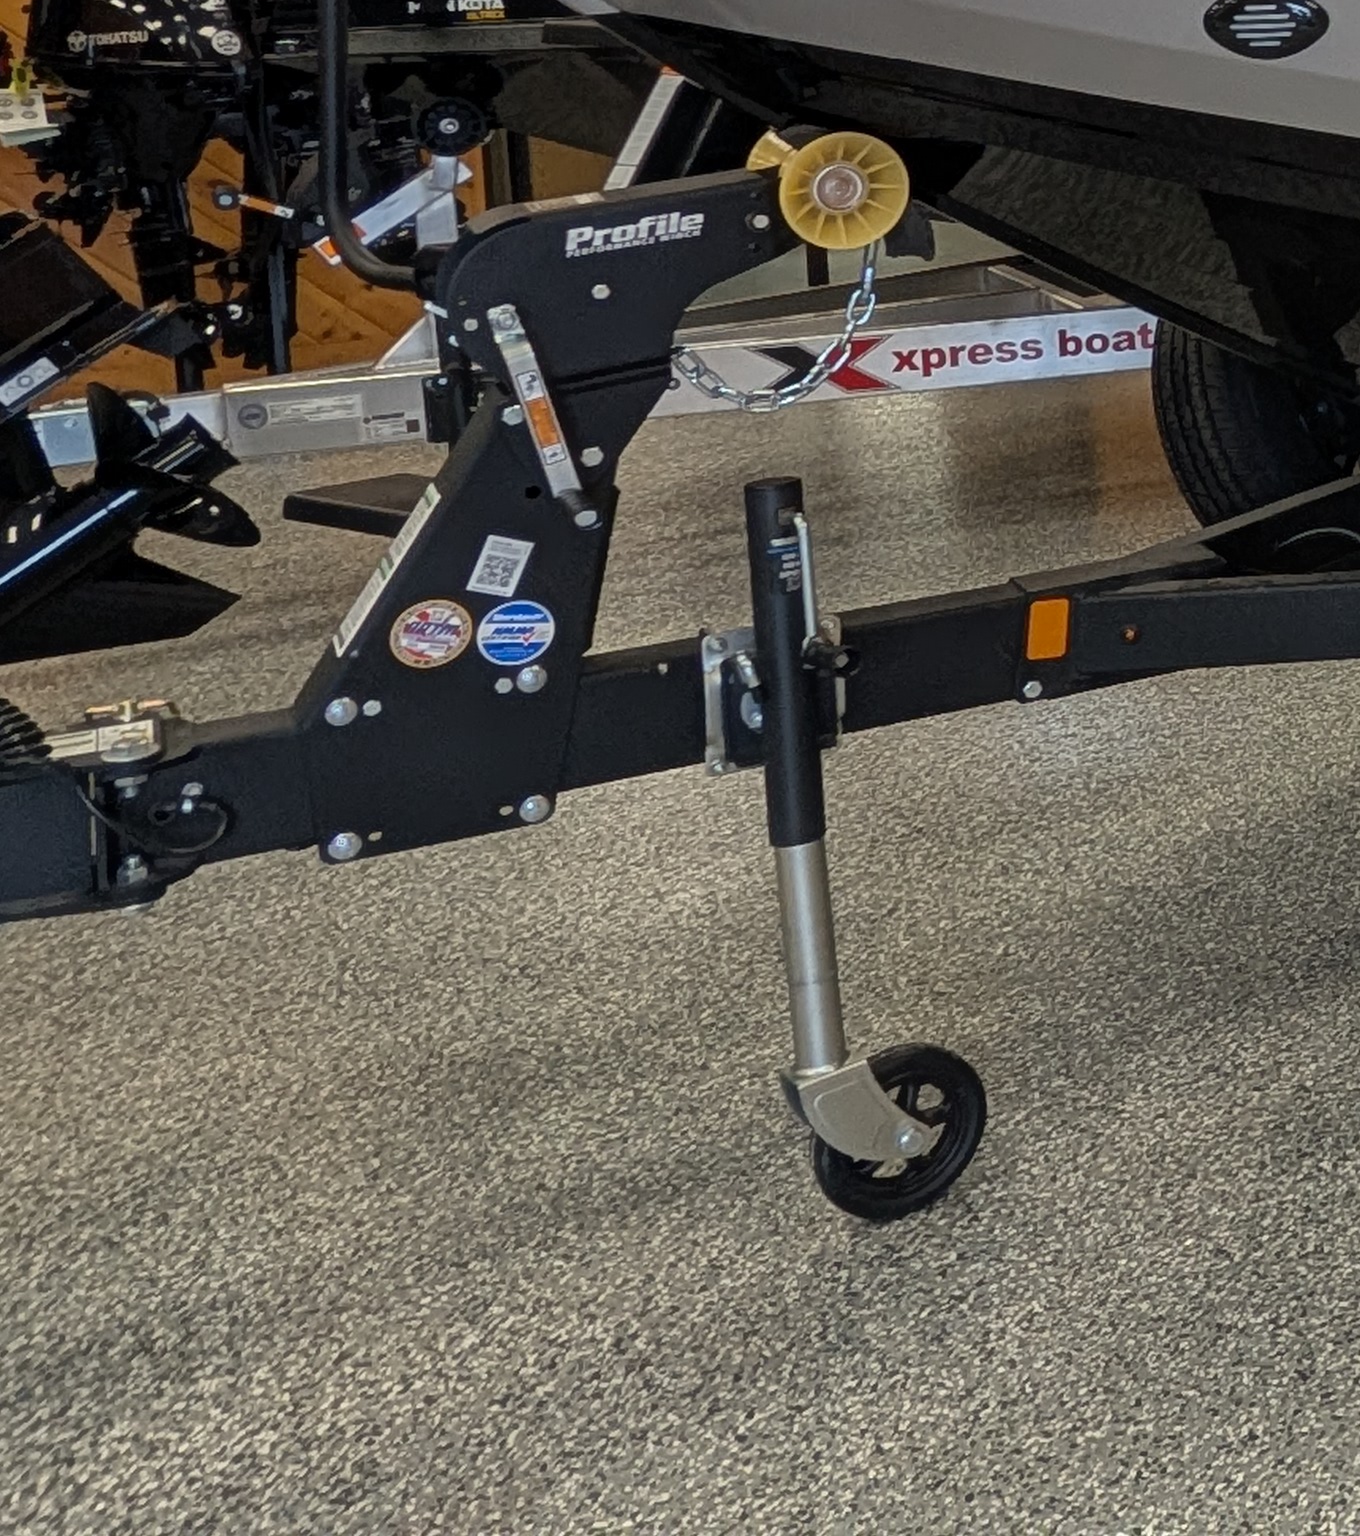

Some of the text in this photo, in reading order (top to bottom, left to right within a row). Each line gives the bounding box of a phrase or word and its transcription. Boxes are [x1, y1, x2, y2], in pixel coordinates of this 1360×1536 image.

[88, 30, 149, 46] TOHATSU
[565, 211, 705, 251] Profile
[891, 321, 1158, 378] xpress boat
